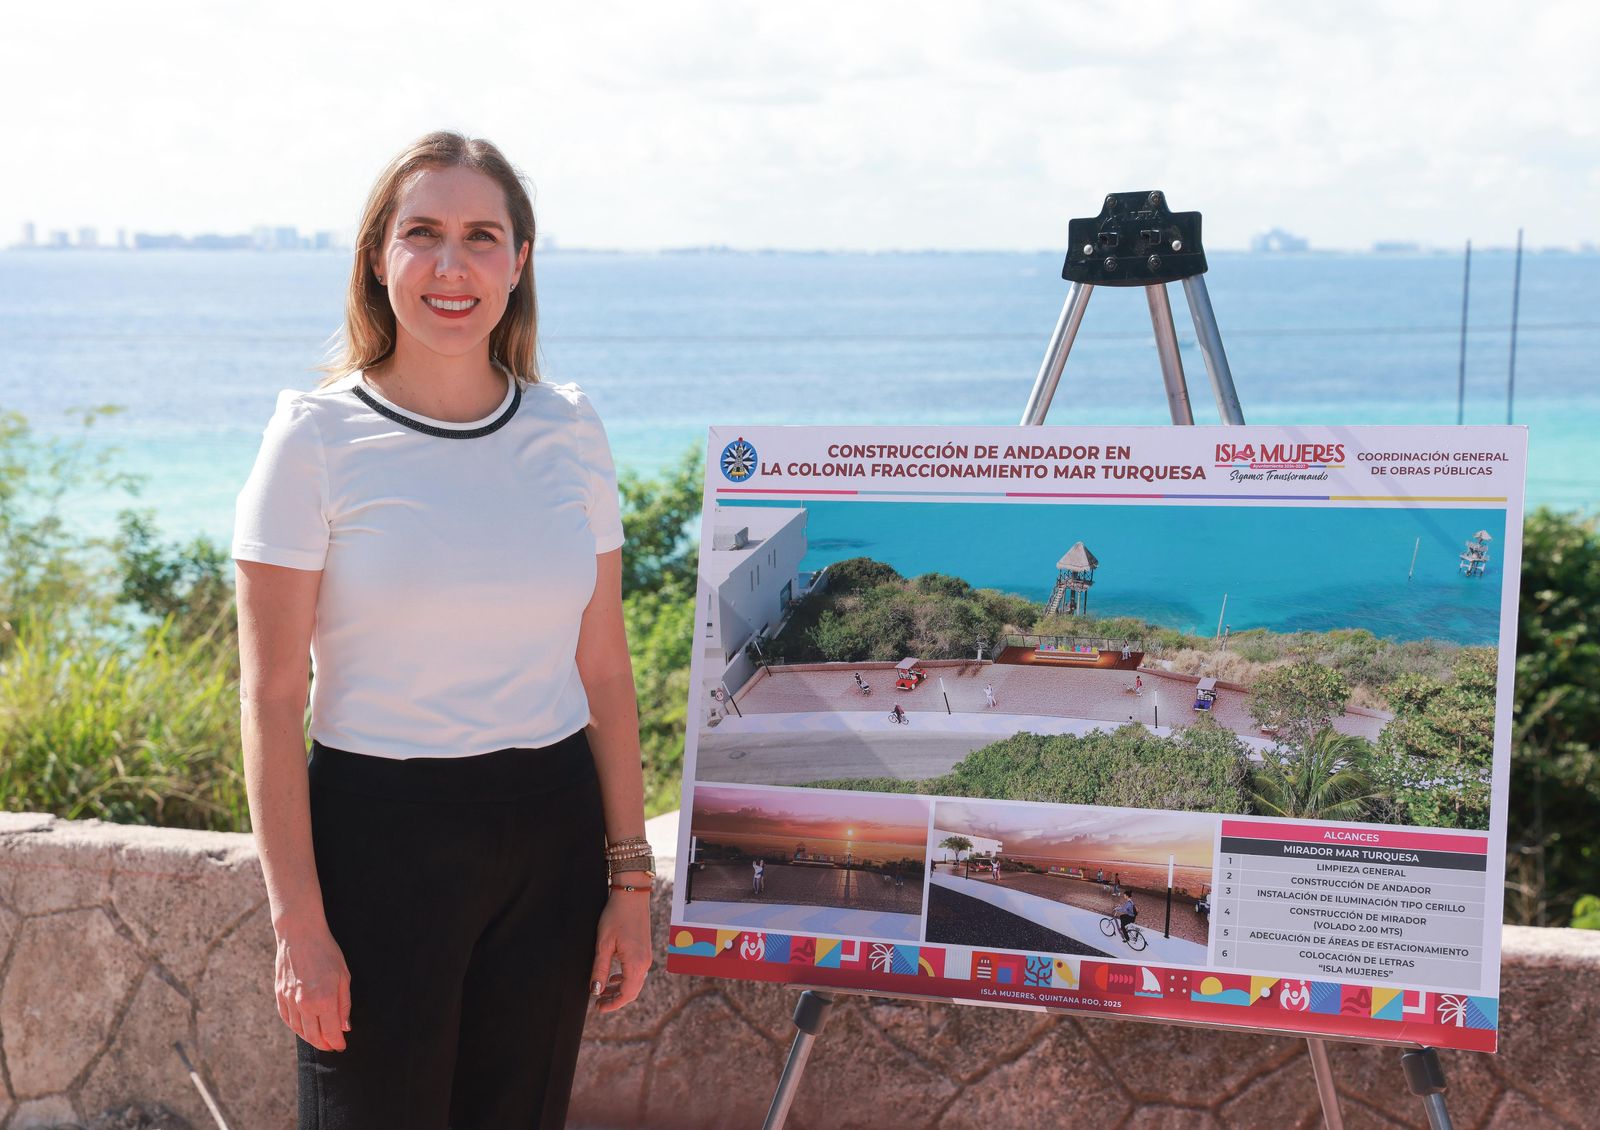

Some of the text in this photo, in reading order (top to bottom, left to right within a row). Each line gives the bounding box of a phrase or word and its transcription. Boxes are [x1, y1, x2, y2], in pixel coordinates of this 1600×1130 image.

[828, 442, 1131, 460] CONSTRUCCIÓN DE ANDADOR EN
[1216, 444, 1345, 462] ISLA MUJERES
[1357, 450, 1509, 462] COORDINACIÓN GENERAL
[761, 463, 1206, 482] LA COLONIA FRACCIONAMIENTO MAR TURQUESA
[1230, 470, 1328, 483] Sigamos Transformando
[1371, 463, 1493, 476] DE OBRAS PÚBLICAS
[1324, 831, 1380, 843] ALCANCES
[1283, 845, 1420, 863] MIRADOR MAR TURQUESA
[1226, 872, 1232, 880] 2
[1316, 864, 1406, 877] LIMPIEZA GENERAL
[1226, 887, 1231, 895] 3
[1290, 877, 1432, 895] CONSTRUCCIÓN DE ANDADOR
[1257, 889, 1466, 913] INSTALACIÓN DE ILUMINACIÓN TIPO CERILLO
[1289, 907, 1427, 925] CONSTRUCCIÓN DE MIRADOR
[1223, 929, 1229, 937] 5
[1313, 921, 1403, 937] (VOLADO 2.00 MTS)
[1249, 931, 1469, 957] ADECUACIÓN DE ÁREAS DE ESTACIONAMIENTO
[1222, 950, 1228, 958] 6
[1299, 950, 1415, 968] COLOCACIÓN DE LETRAS
[1039, 994, 1080, 1003] QUINTANA
[1082, 998, 1101, 1006] ROO,
[1104, 1000, 1122, 1008] 2025
